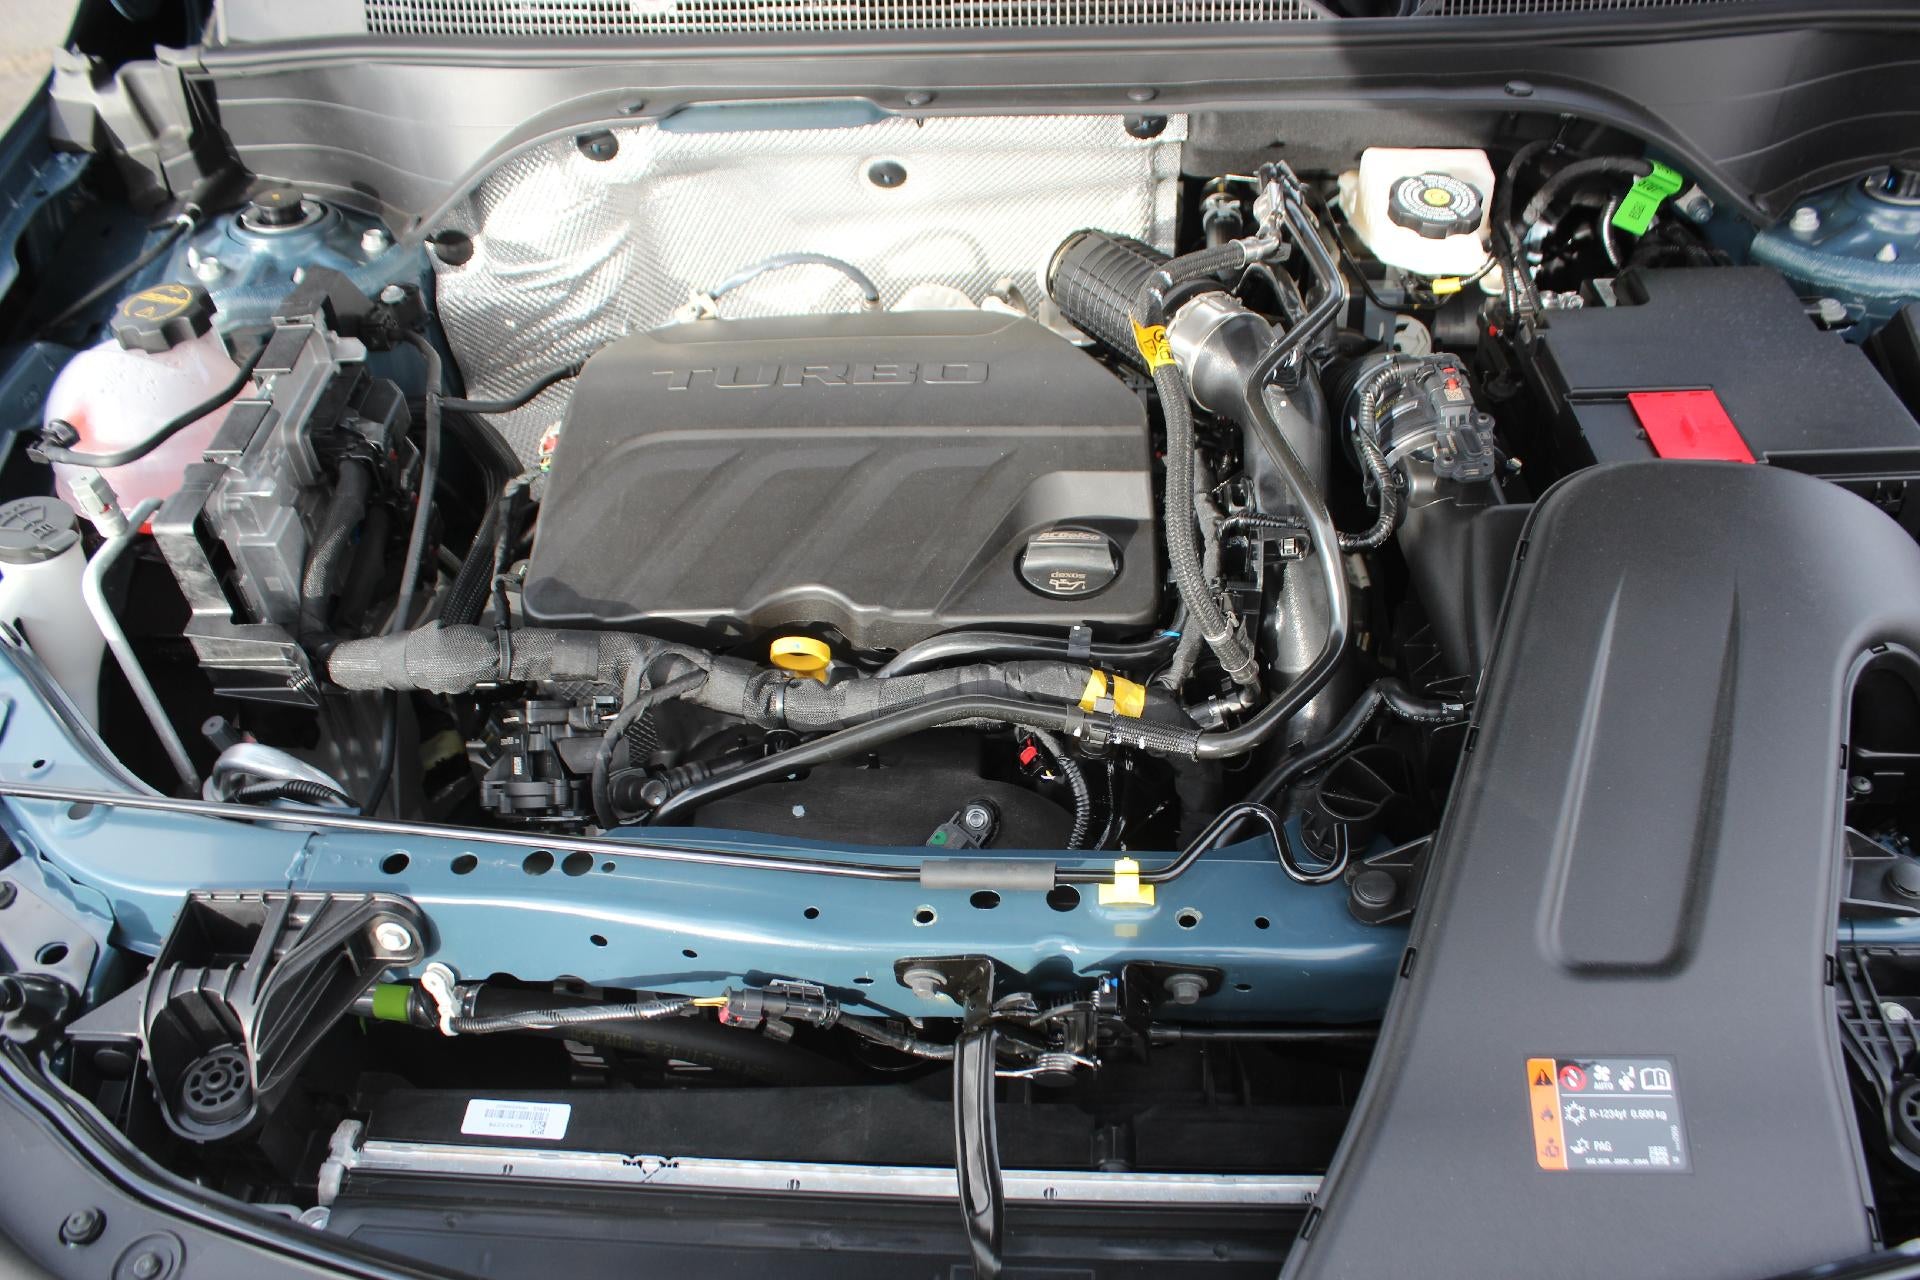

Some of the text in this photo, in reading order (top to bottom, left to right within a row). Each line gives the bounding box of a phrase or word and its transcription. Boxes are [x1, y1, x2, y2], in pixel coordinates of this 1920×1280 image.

[652, 362, 990, 391] TURBO
[1050, 571, 1087, 579] dexos
[1593, 1082, 1614, 1091] AUTO
[1589, 1108, 1628, 1121] R-1234yf
[1655, 1109, 1668, 1122] kg
[1593, 1140, 1614, 1152] PAG
